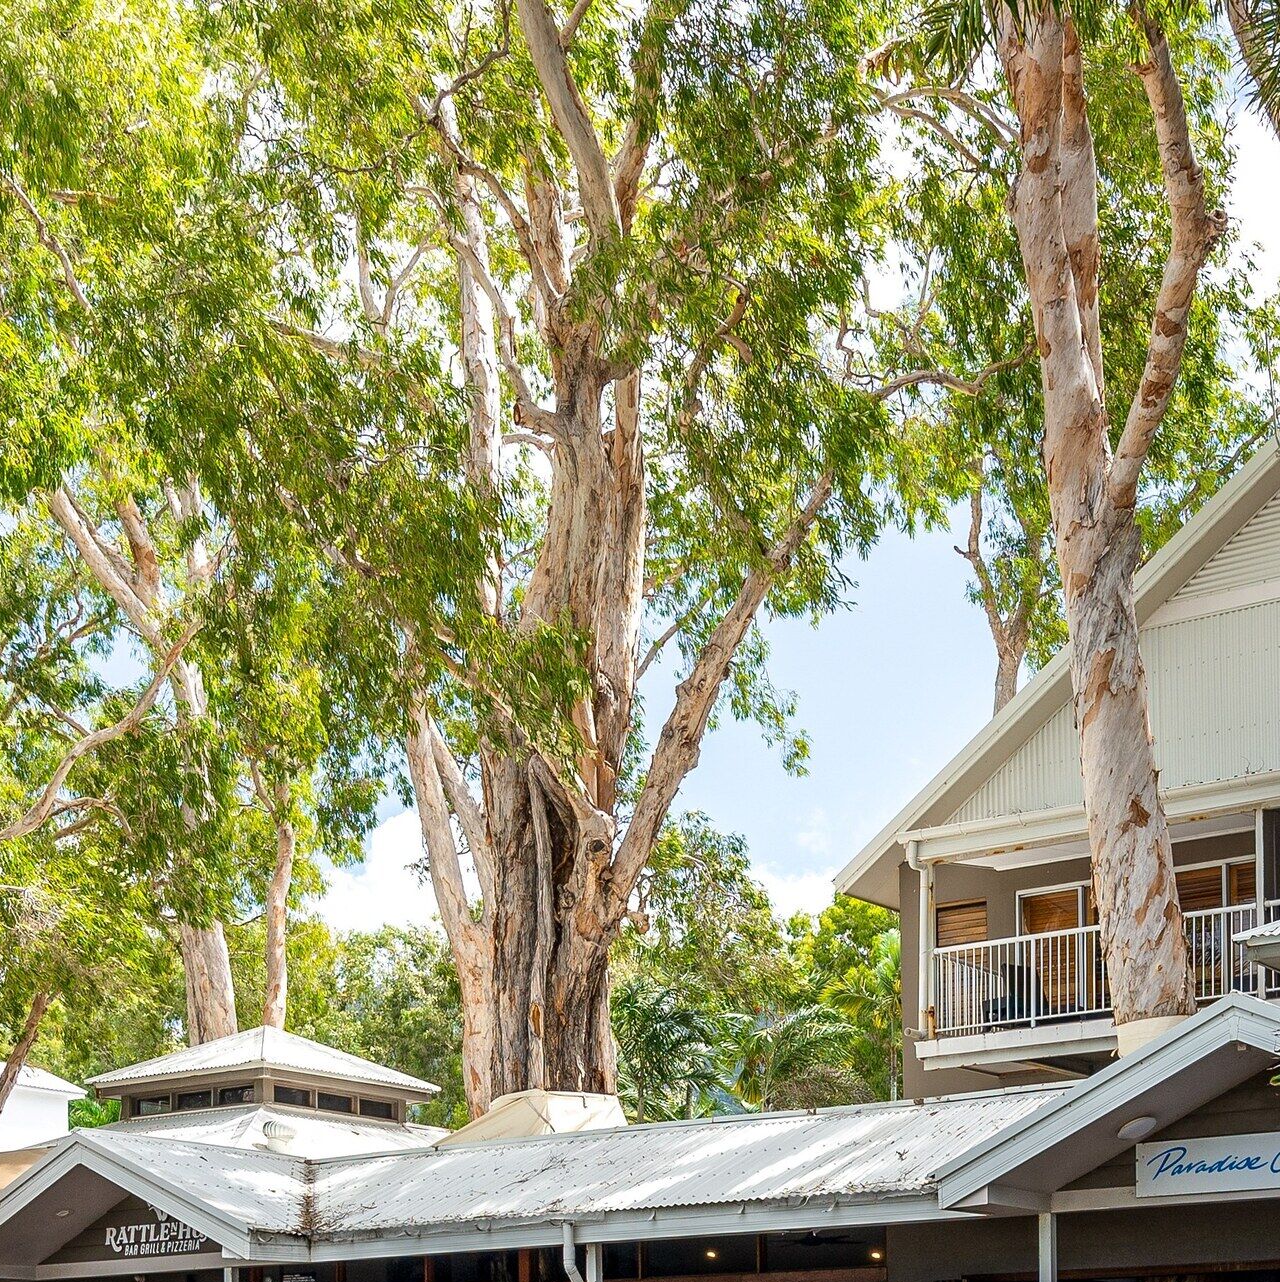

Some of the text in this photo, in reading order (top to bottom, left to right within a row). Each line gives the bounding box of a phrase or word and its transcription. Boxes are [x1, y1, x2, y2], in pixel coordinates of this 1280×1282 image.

[1147, 1146, 1273, 1181] Paradise
[124, 1244, 138, 1256] BAR
[140, 1241, 160, 1255] GRILL
[167, 1239, 200, 1253] PIZZERIA
